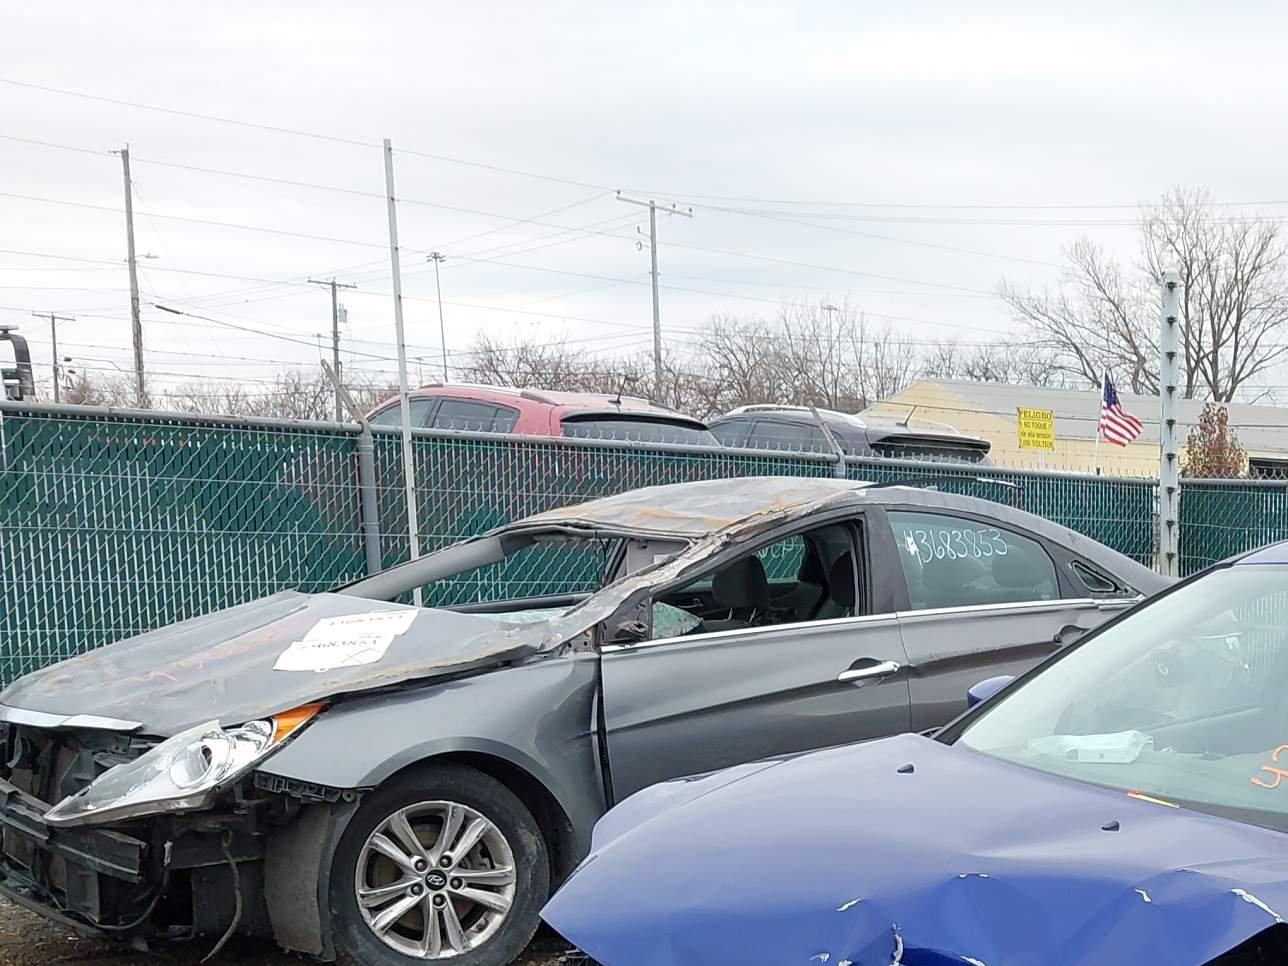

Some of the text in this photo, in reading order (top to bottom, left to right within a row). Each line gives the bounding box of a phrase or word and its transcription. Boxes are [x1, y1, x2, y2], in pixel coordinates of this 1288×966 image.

[1019, 410, 1052, 420] PELIGRO
[1023, 421, 1048, 430] NO TOQUE
[904, 529, 1008, 568] 43683853
